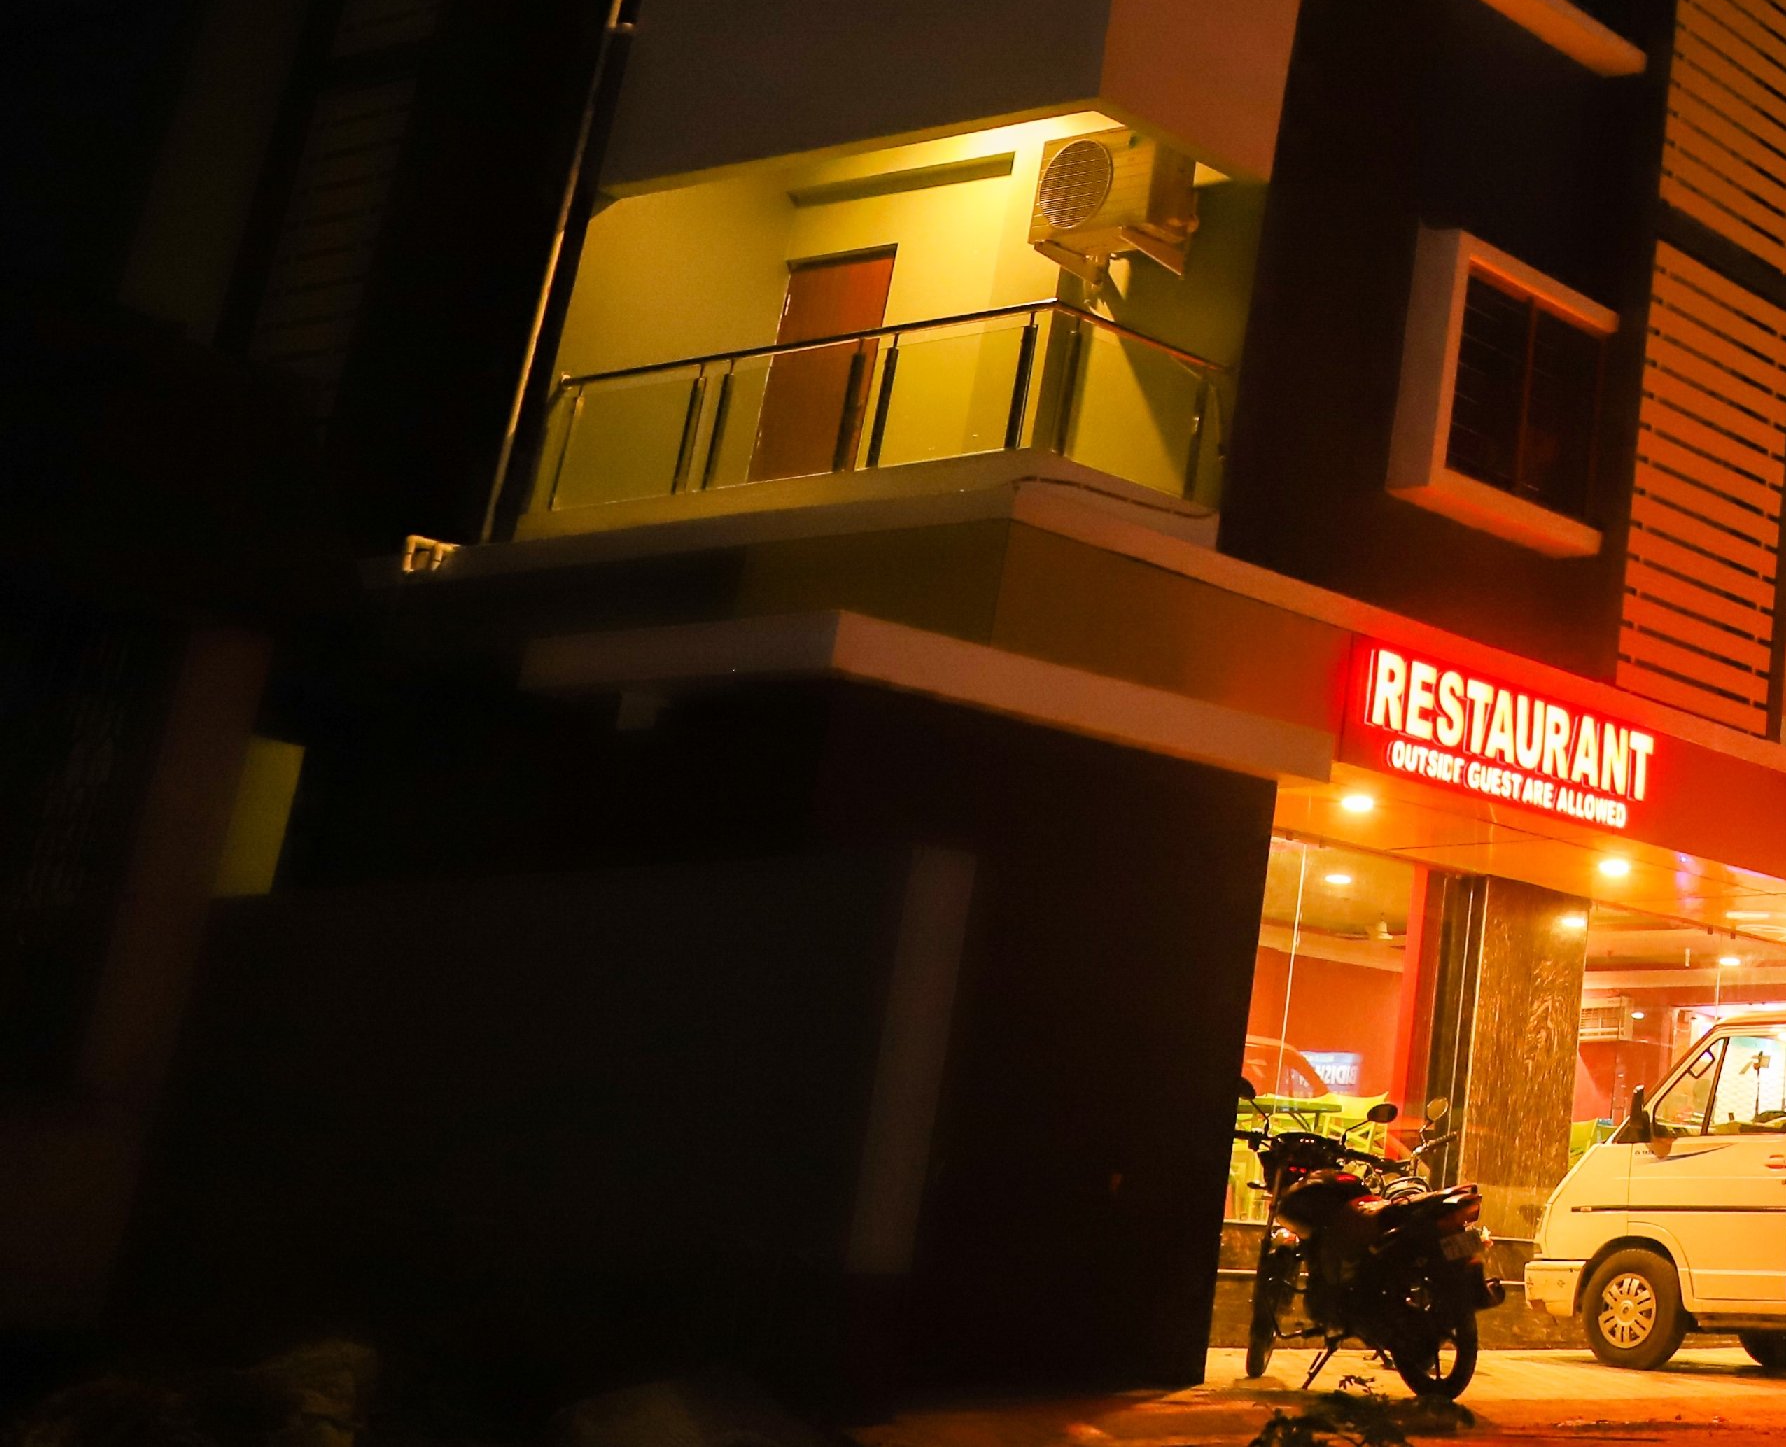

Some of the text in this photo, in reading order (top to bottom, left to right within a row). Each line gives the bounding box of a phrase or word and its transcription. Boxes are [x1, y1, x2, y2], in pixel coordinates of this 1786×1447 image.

[1370, 649, 1654, 801] RESTAURANT
[1467, 761, 1522, 801] GUEST
[1522, 776, 1555, 809] ARE
[1556, 787, 1627, 828] ALLOWED
